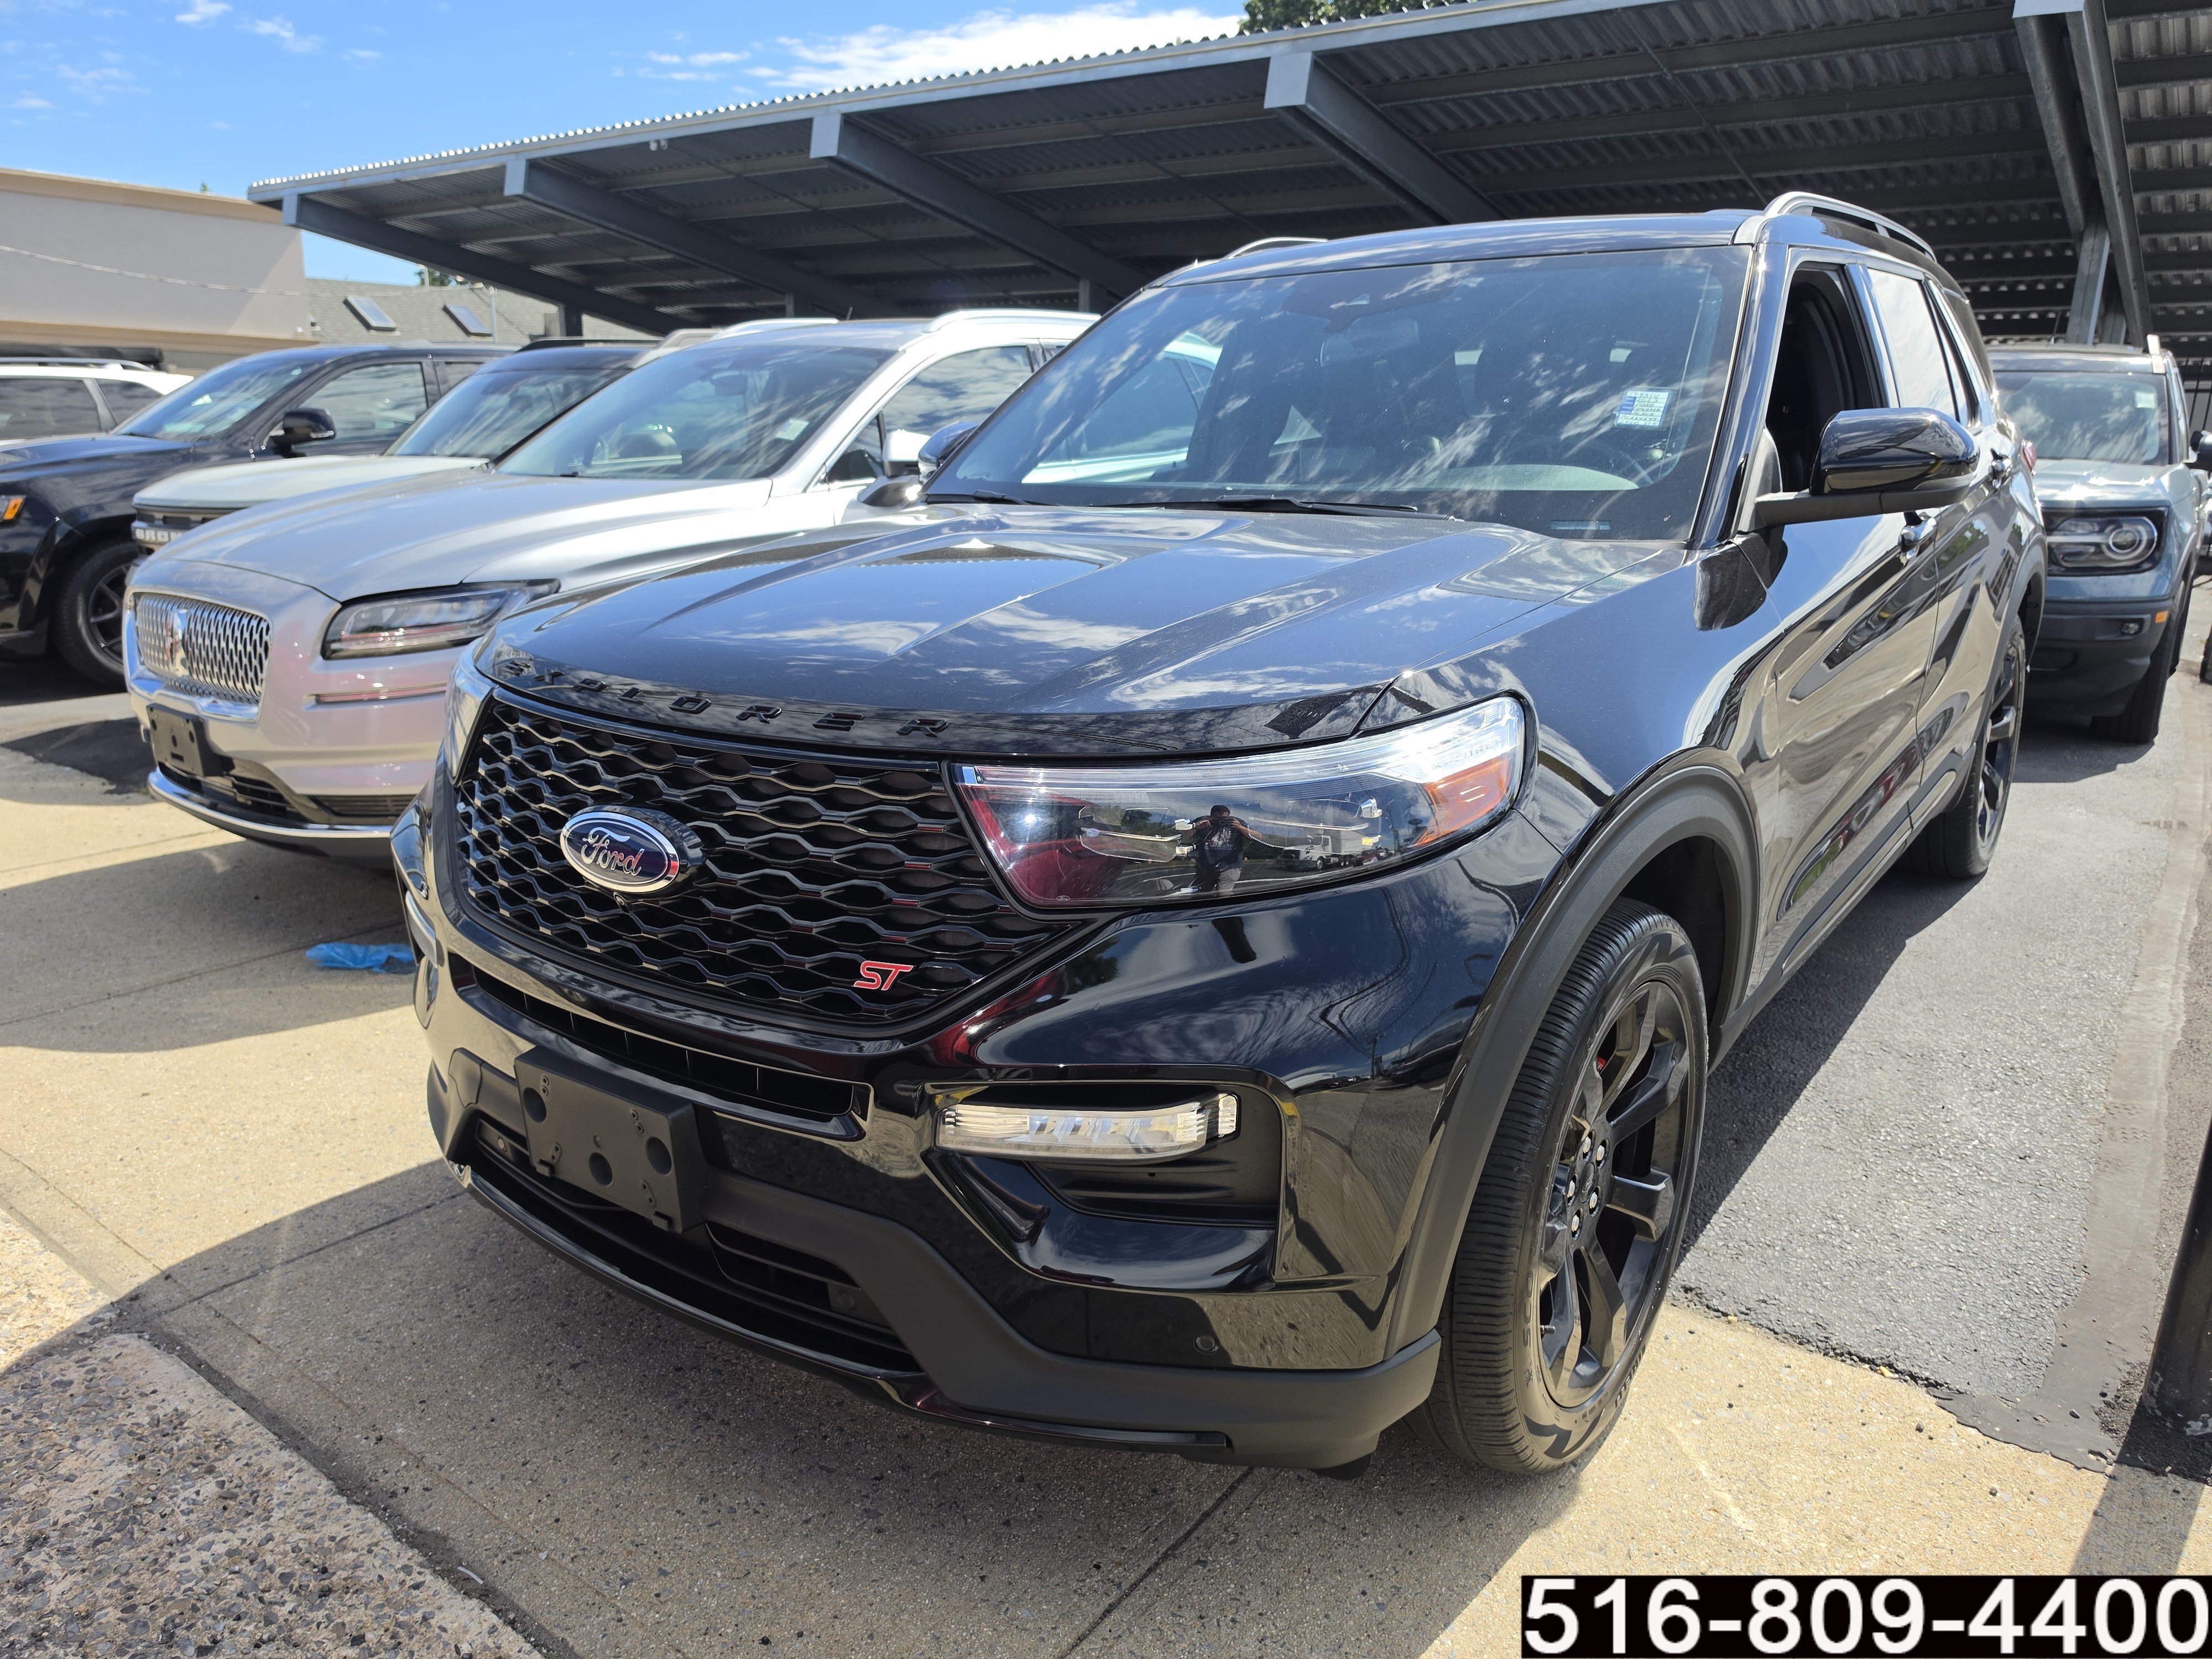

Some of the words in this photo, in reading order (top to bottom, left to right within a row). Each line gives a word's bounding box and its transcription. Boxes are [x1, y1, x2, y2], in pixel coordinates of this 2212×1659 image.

[505, 660, 949, 738] EXPLORER
[581, 827, 645, 877] Ford
[852, 960, 915, 991] ST
